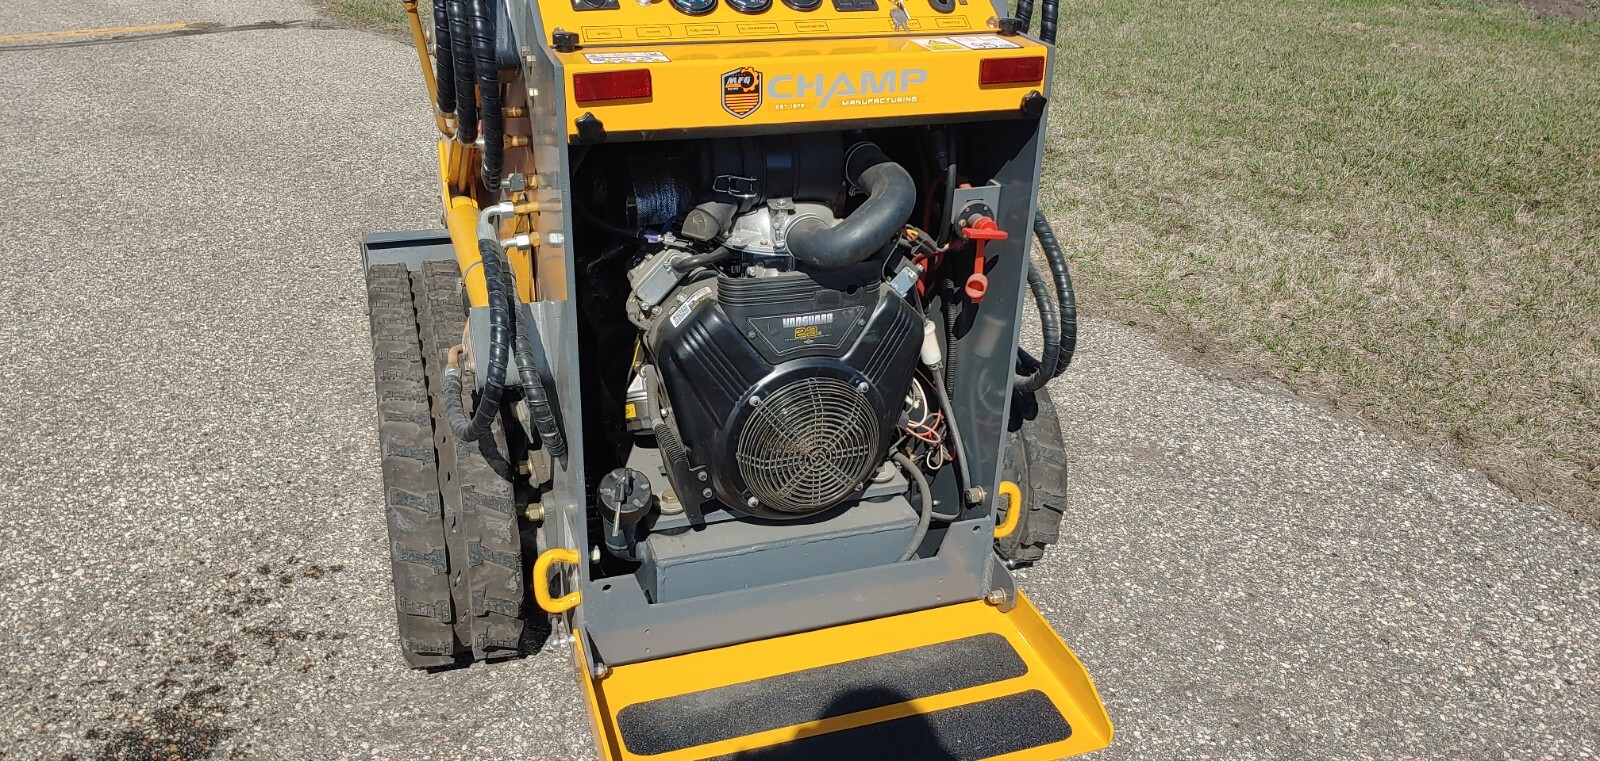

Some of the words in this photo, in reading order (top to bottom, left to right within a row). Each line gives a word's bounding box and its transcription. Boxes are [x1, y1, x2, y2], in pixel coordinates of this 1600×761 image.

[727, 76, 751, 85] MFG
[767, 68, 928, 109] CHAMP
[841, 96, 918, 106] MANUFACTURING
[782, 313, 834, 328] VANGUARD
[794, 326, 818, 339] 23
